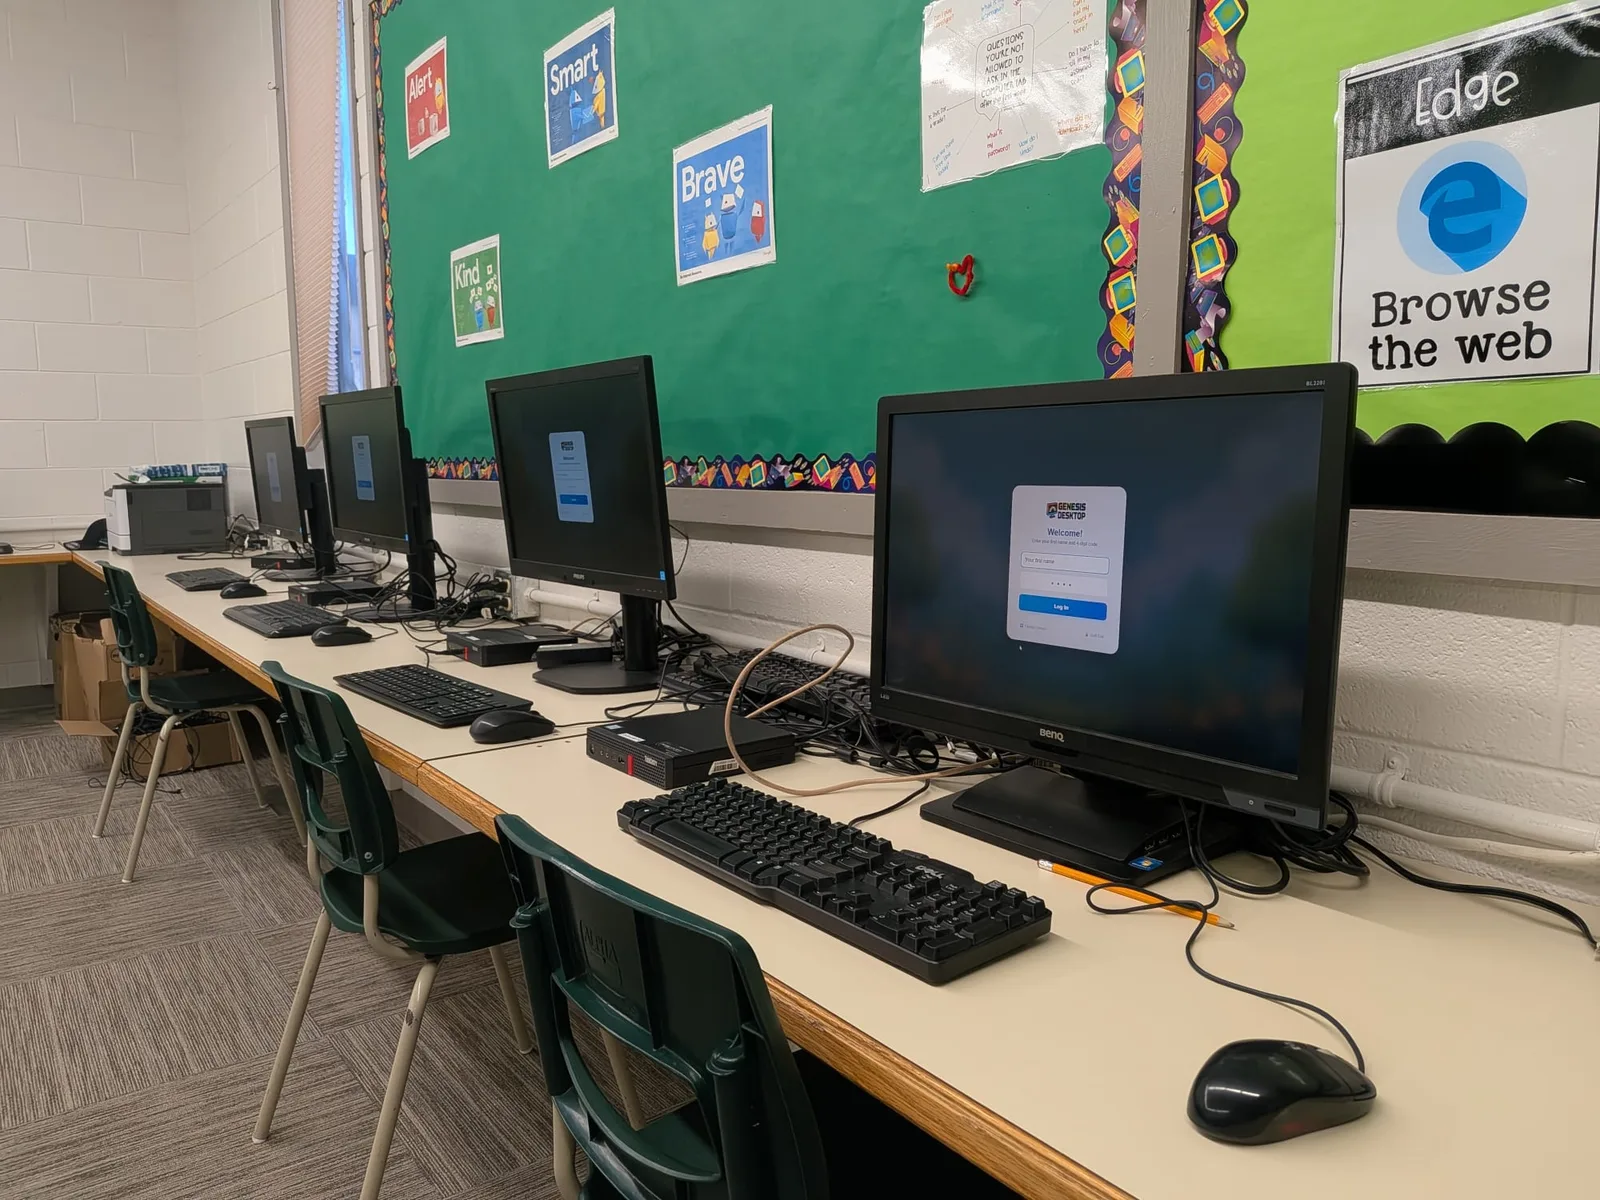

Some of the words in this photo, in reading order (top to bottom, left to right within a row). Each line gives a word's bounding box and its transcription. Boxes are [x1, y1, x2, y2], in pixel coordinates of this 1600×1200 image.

[986, 31, 1024, 52] QUESTIONS
[986, 48, 1009, 63] YOU'RE
[1011, 42, 1024, 54] NOT
[551, 43, 599, 95] Smart
[985, 58, 1013, 75] ALLOWED
[1015, 55, 1024, 64] TO
[987, 75, 999, 84] ASK
[1001, 72, 1008, 81] IN
[1010, 66, 1021, 77] THE
[409, 66, 432, 103] Alert
[981, 81, 1014, 98] COMPUTER
[1015, 76, 1026, 88] LAB
[1415, 68, 1519, 126] Edge
[682, 155, 745, 203] Brave
[455, 258, 480, 290] Kind
[1371, 279, 1551, 328] Browse
[1368, 334, 1438, 371] the
[1454, 321, 1553, 364] web
[1057, 511, 1086, 520] DESKTOP
[1058, 502, 1086, 511] GENESIS
[1047, 528, 1083, 537] Welcome!
[1040, 728, 1065, 743] BenQ
[915, 865, 945, 879] DELL
